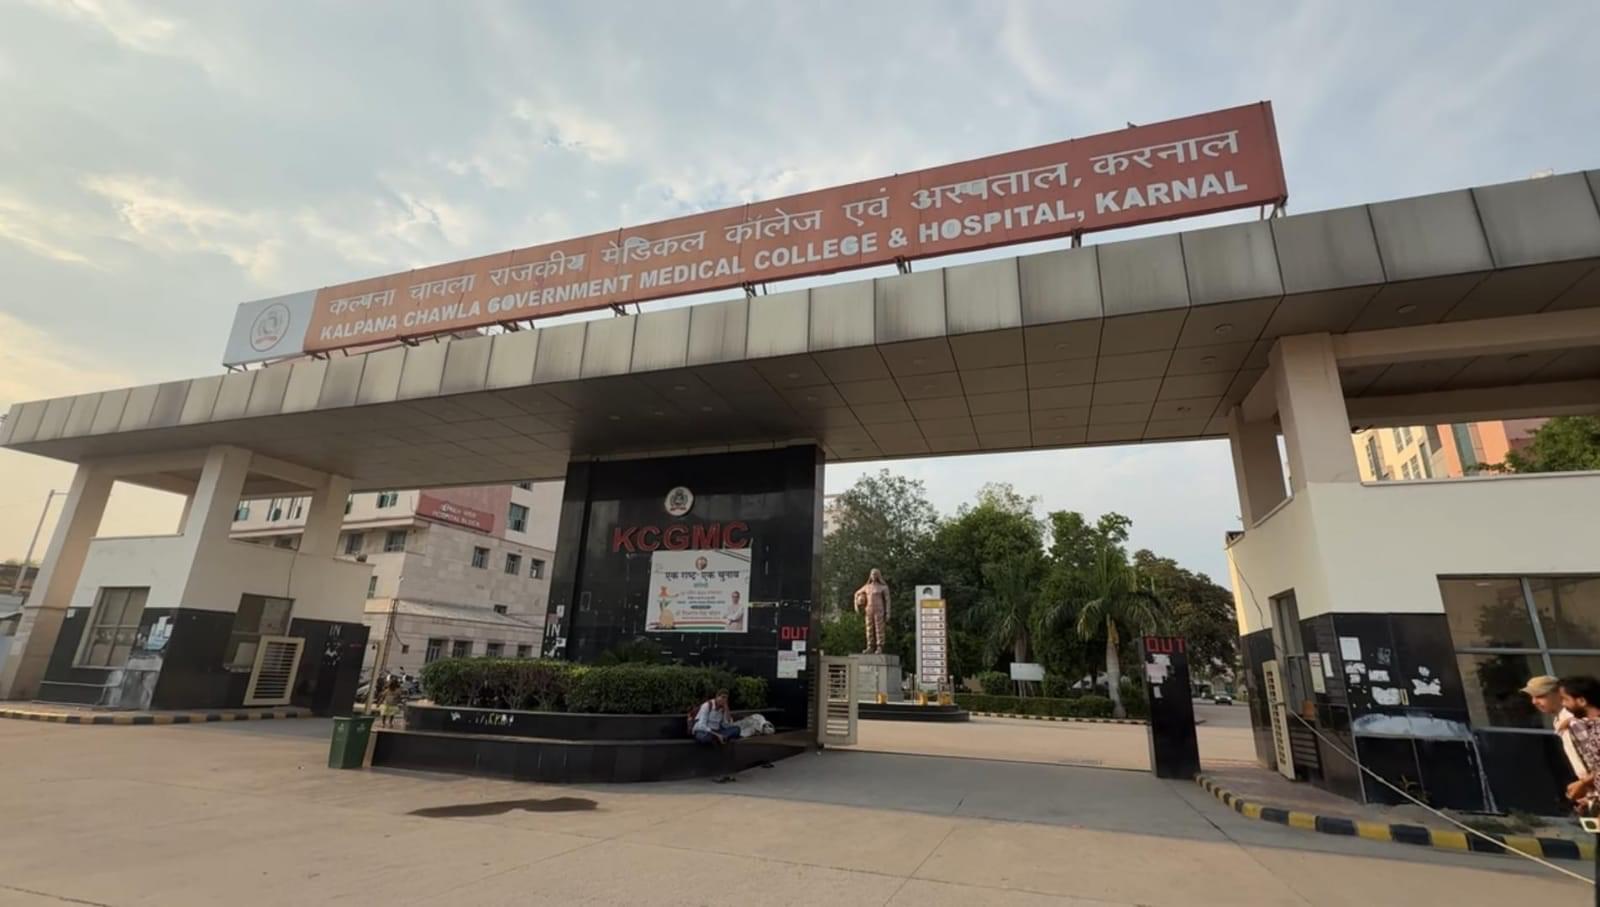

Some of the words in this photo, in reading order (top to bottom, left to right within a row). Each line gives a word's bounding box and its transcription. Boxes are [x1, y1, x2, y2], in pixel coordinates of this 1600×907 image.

[328, 288, 397, 316] कल्पना
[408, 273, 477, 300] चावला
[488, 249, 587, 287] राजकीय
[601, 230, 707, 264] मेडिकल
[842, 187, 890, 228] एवं
[1089, 129, 1239, 176] करनाल
[319, 314, 398, 341] KALPANA
[403, 300, 481, 327] CHAWLA
[487, 273, 633, 315] GOVERNMENT
[639, 255, 745, 289] MEDICAL
[754, 232, 878, 270] COLLEGE
[887, 227, 908, 249] &
[918, 200, 1085, 243] HOSPITAL,
[1095, 170, 1249, 214] KARNAL
[612, 521, 749, 552] KCGMC
[329, 623, 342, 637] IN
[546, 623, 561, 638] IN
[781, 626, 809, 640] OUT
[1145, 637, 1185, 653] OUT
